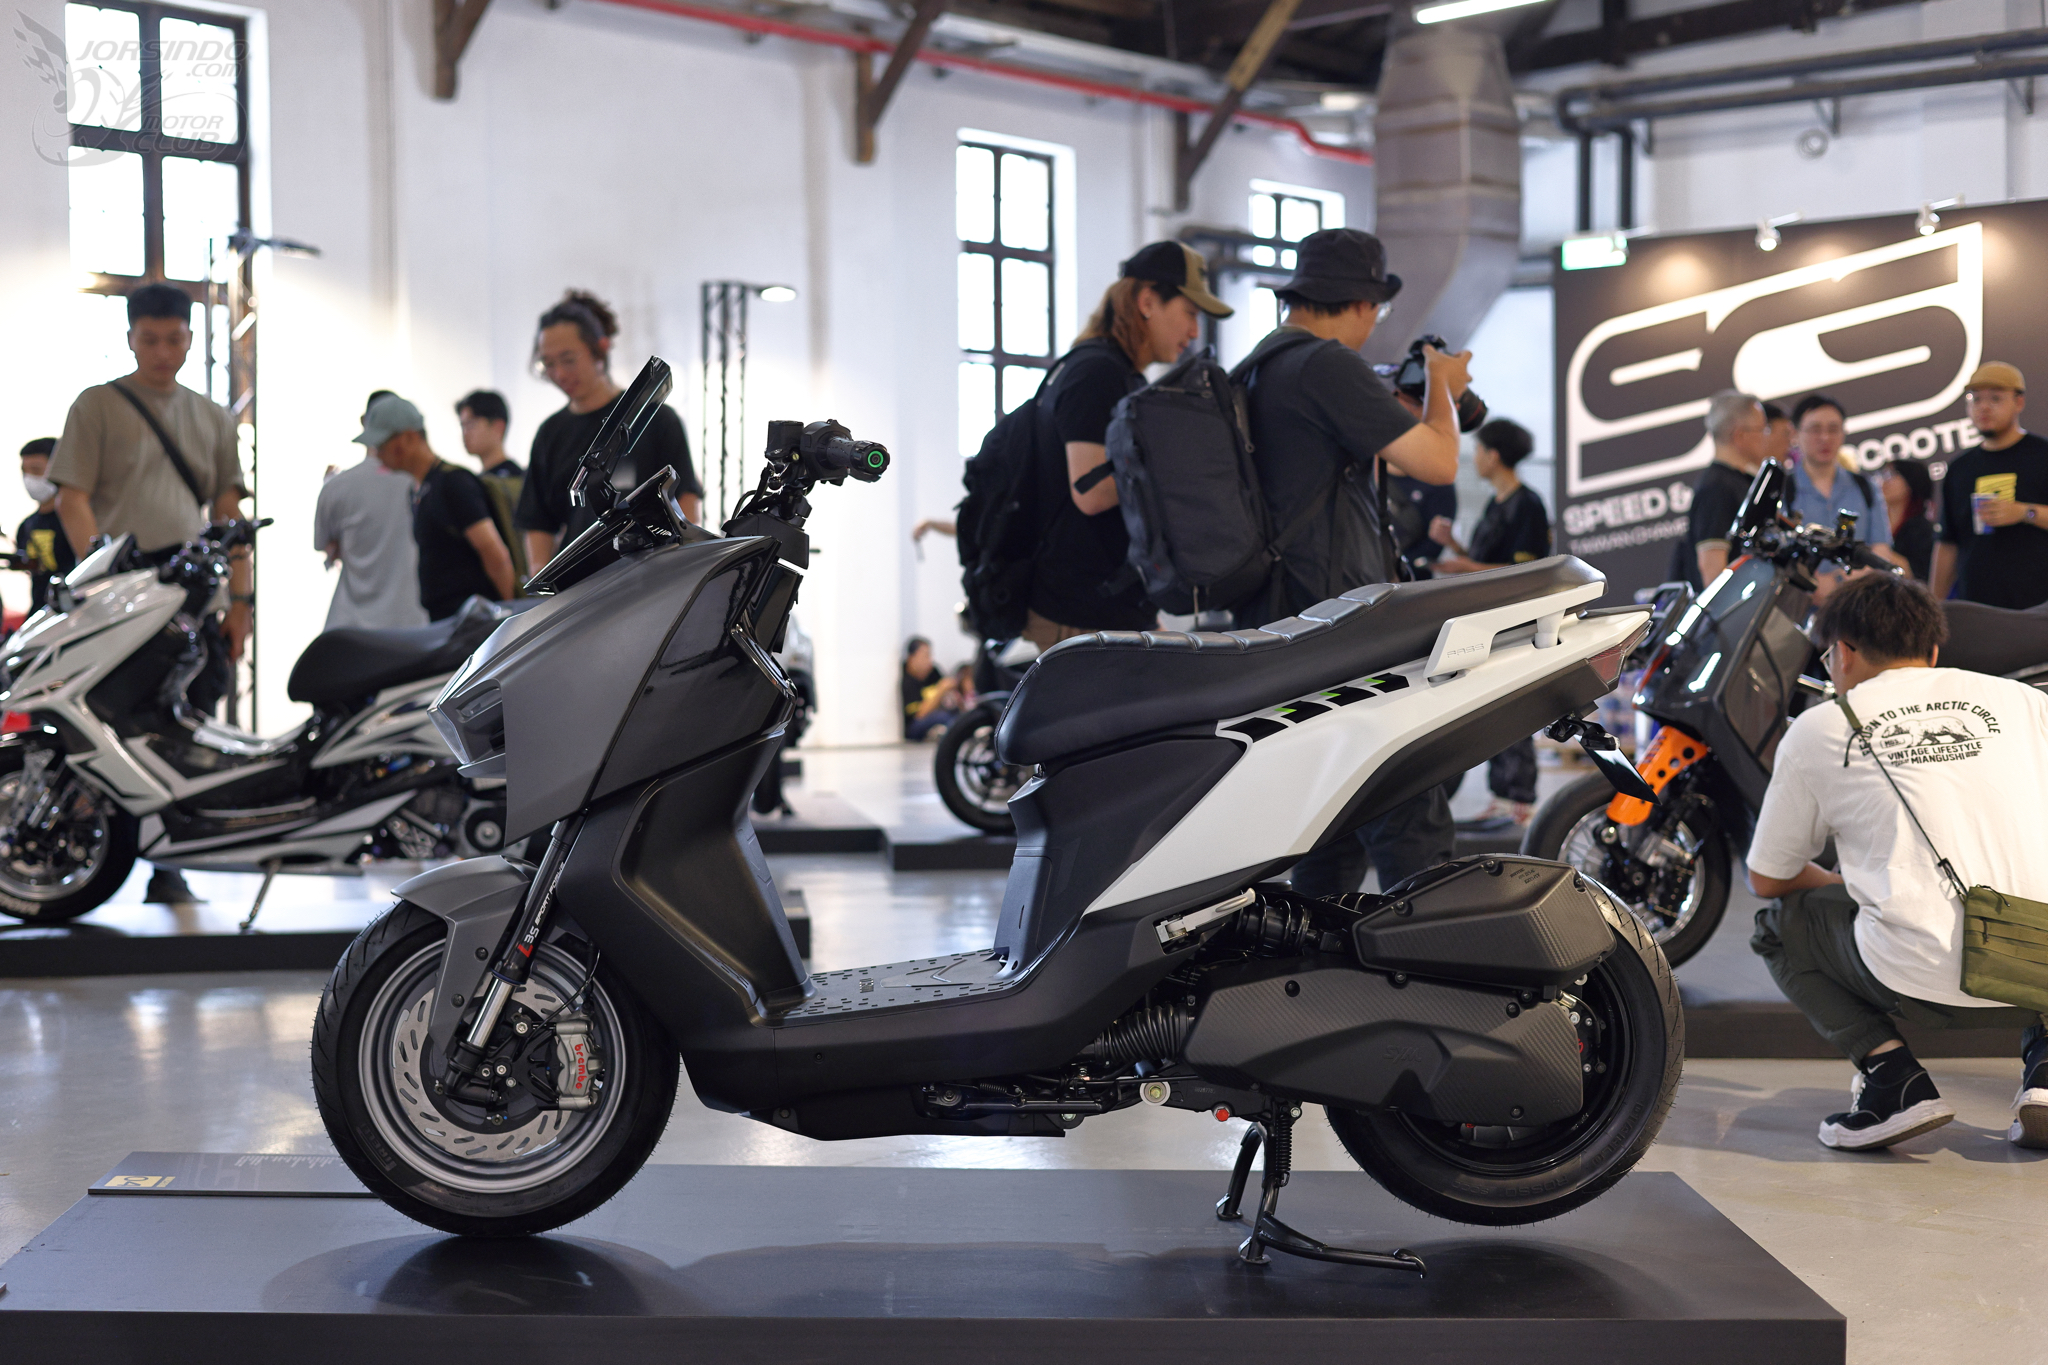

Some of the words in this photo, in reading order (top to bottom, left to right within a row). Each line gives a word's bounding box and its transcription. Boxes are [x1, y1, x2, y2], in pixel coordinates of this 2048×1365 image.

[1562, 487, 1668, 536] SPEED
[1838, 417, 1986, 474] COOTE
[1879, 710, 1897, 722] TO
[1898, 704, 1922, 716] THE
[1926, 701, 1970, 712] ARCTIC
[1971, 705, 2001, 734] CIRCLE
[1887, 747, 1930, 760] VINTAGE
[1932, 741, 1983, 754] LIFESTYLE
[1910, 753, 1966, 765] MIANGUSHI
[534, 892, 551, 926] SPORT
[574, 1043, 587, 1089] brembo
[356, 1121, 397, 1172] PIRELLI
